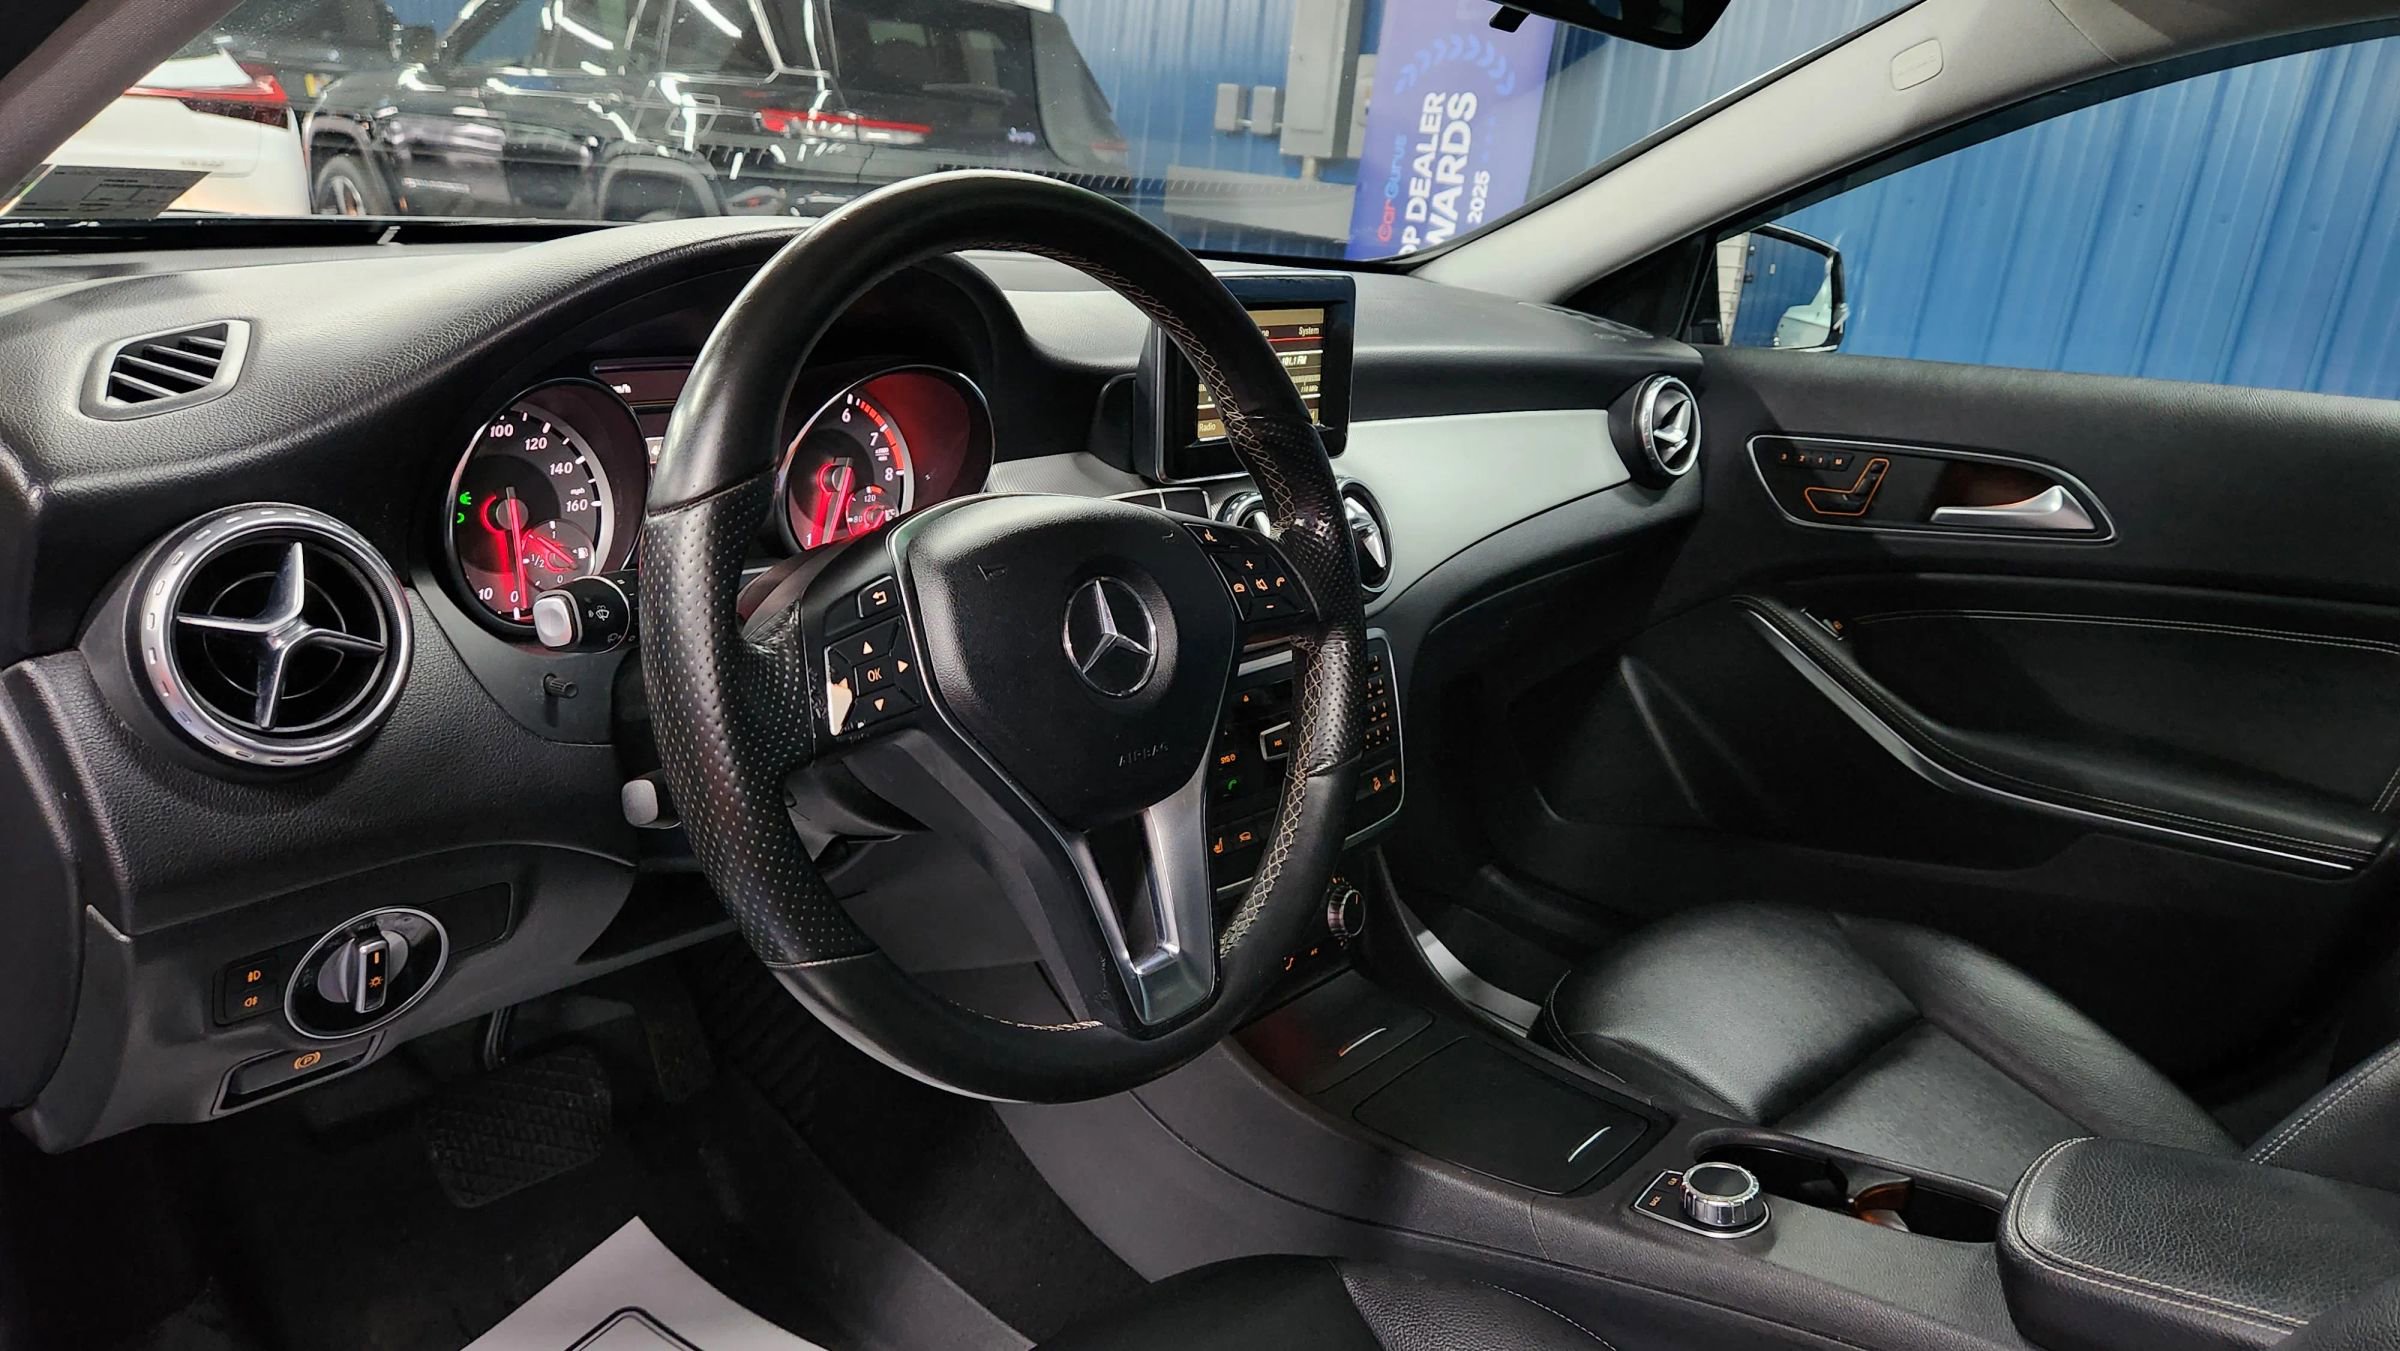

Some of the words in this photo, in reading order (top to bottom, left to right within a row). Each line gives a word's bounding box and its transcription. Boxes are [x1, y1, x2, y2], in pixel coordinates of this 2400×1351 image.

[1405, 92, 1446, 222] DEALER
[1425, 92, 1478, 246] WARDS
[1377, 134, 1407, 243] CarGurus
[1399, 225, 1420, 255] OP
[1298, 326, 1320, 337] System
[841, 408, 851, 423] 6
[490, 424, 514, 438] 100
[1200, 422, 1216, 432] Radio
[525, 437, 548, 451] 120
[870, 432, 879, 446] 7
[550, 462, 573, 475] 140
[885, 467, 894, 481] 8
[864, 494, 876, 502] 120
[566, 499, 588, 512] 160
[806, 532, 812, 546] 1
[531, 553, 545, 568] 1/2
[557, 575, 563, 584] 0
[479, 587, 493, 600] 10
[510, 590, 519, 603] 0
[867, 668, 882, 682] OK
